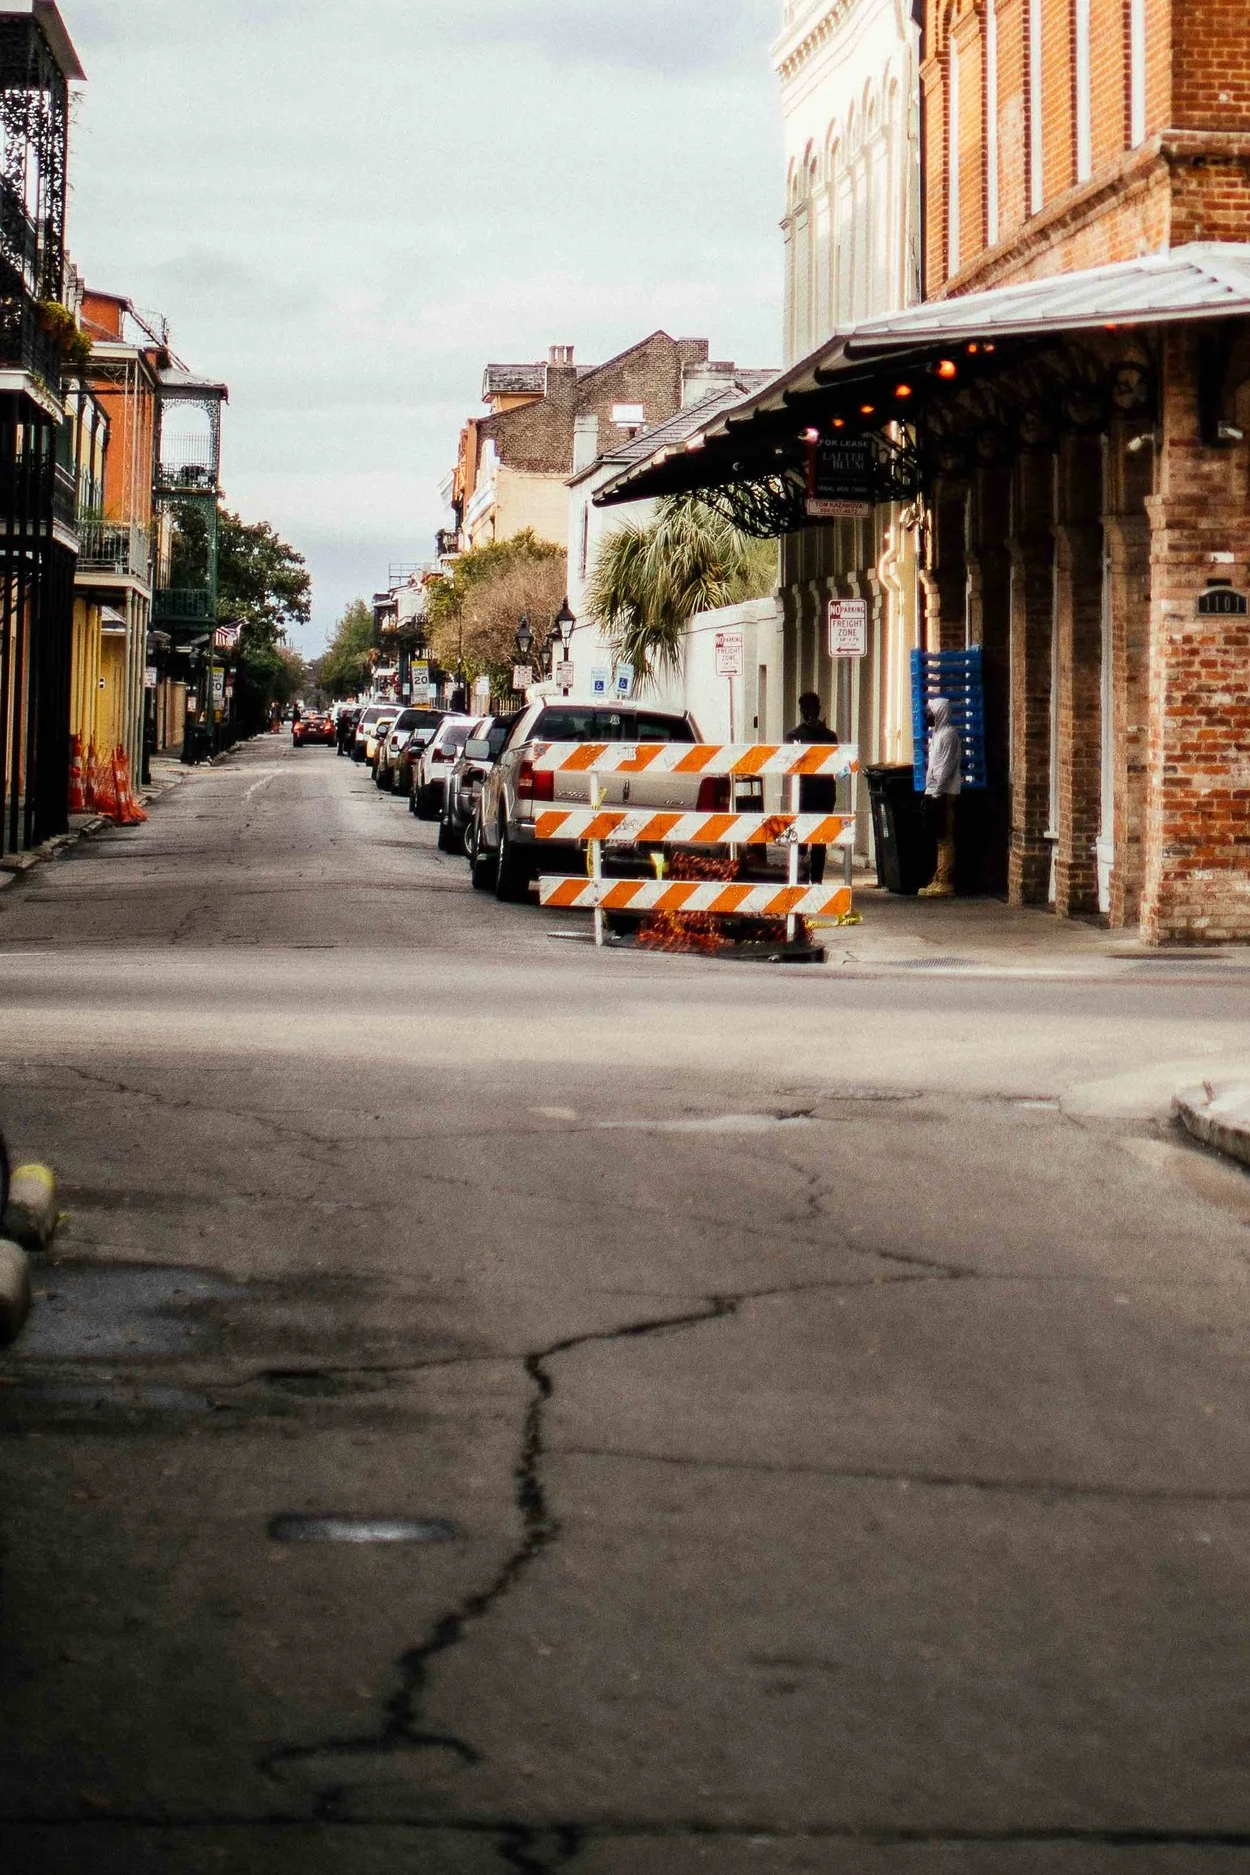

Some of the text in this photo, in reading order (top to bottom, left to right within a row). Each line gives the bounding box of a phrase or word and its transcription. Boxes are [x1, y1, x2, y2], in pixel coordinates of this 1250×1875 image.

[817, 439, 868, 448] FOR LEASE
[1206, 596, 1239, 612] 1101
[831, 604, 841, 615] NO
[832, 620, 862, 628] FREIGHT
[838, 628, 857, 637] ZONE
[414, 676, 428, 685] 20
